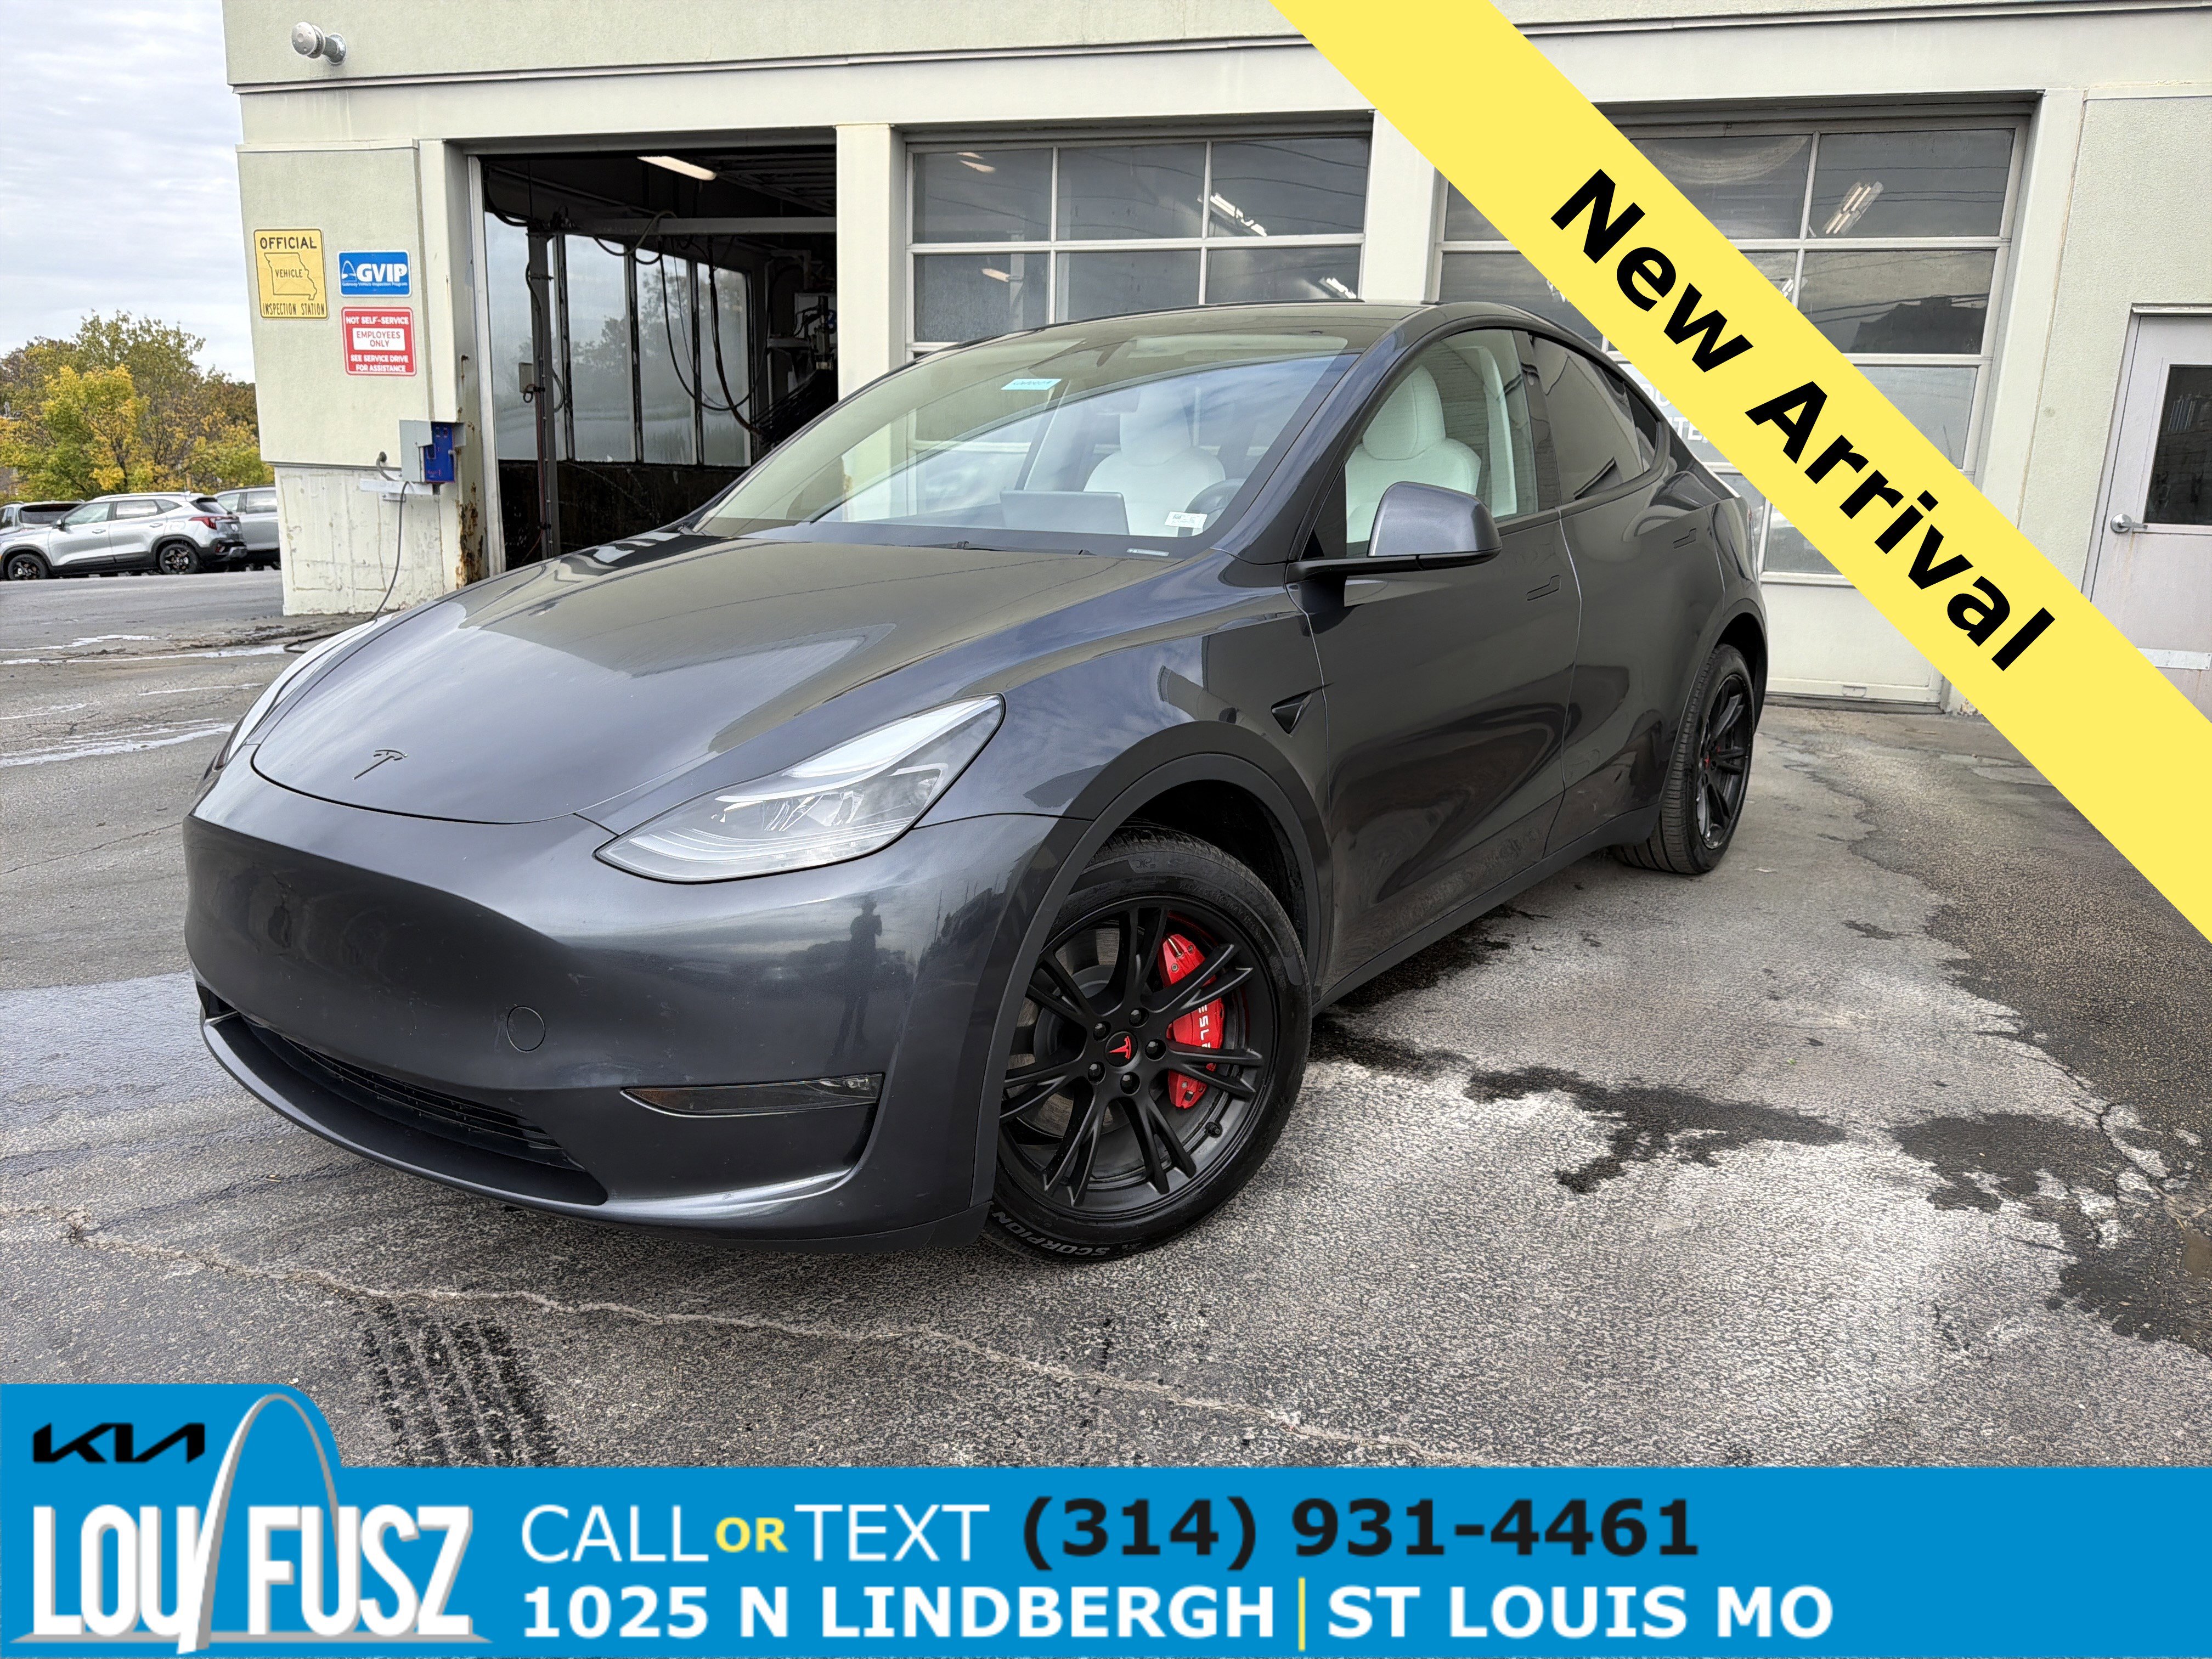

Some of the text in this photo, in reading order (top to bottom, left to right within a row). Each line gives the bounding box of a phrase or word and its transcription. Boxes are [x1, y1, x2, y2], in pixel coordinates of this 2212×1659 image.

[260, 236, 317, 249] OFFICIAL
[275, 269, 303, 278] VEHICLE
[357, 263, 408, 283] GVIP
[262, 303, 325, 315] INSPECTION STATION
[346, 316, 409, 325] NOT SELF-SERVICE
[356, 330, 401, 339] EMPLOYEES
[369, 339, 390, 347] ONLY
[363, 354, 389, 363] SERVICE
[390, 355, 409, 363] DRIVE
[369, 364, 406, 373] ASSISTANCE
[991, 1211, 1110, 1256] SCORPION
